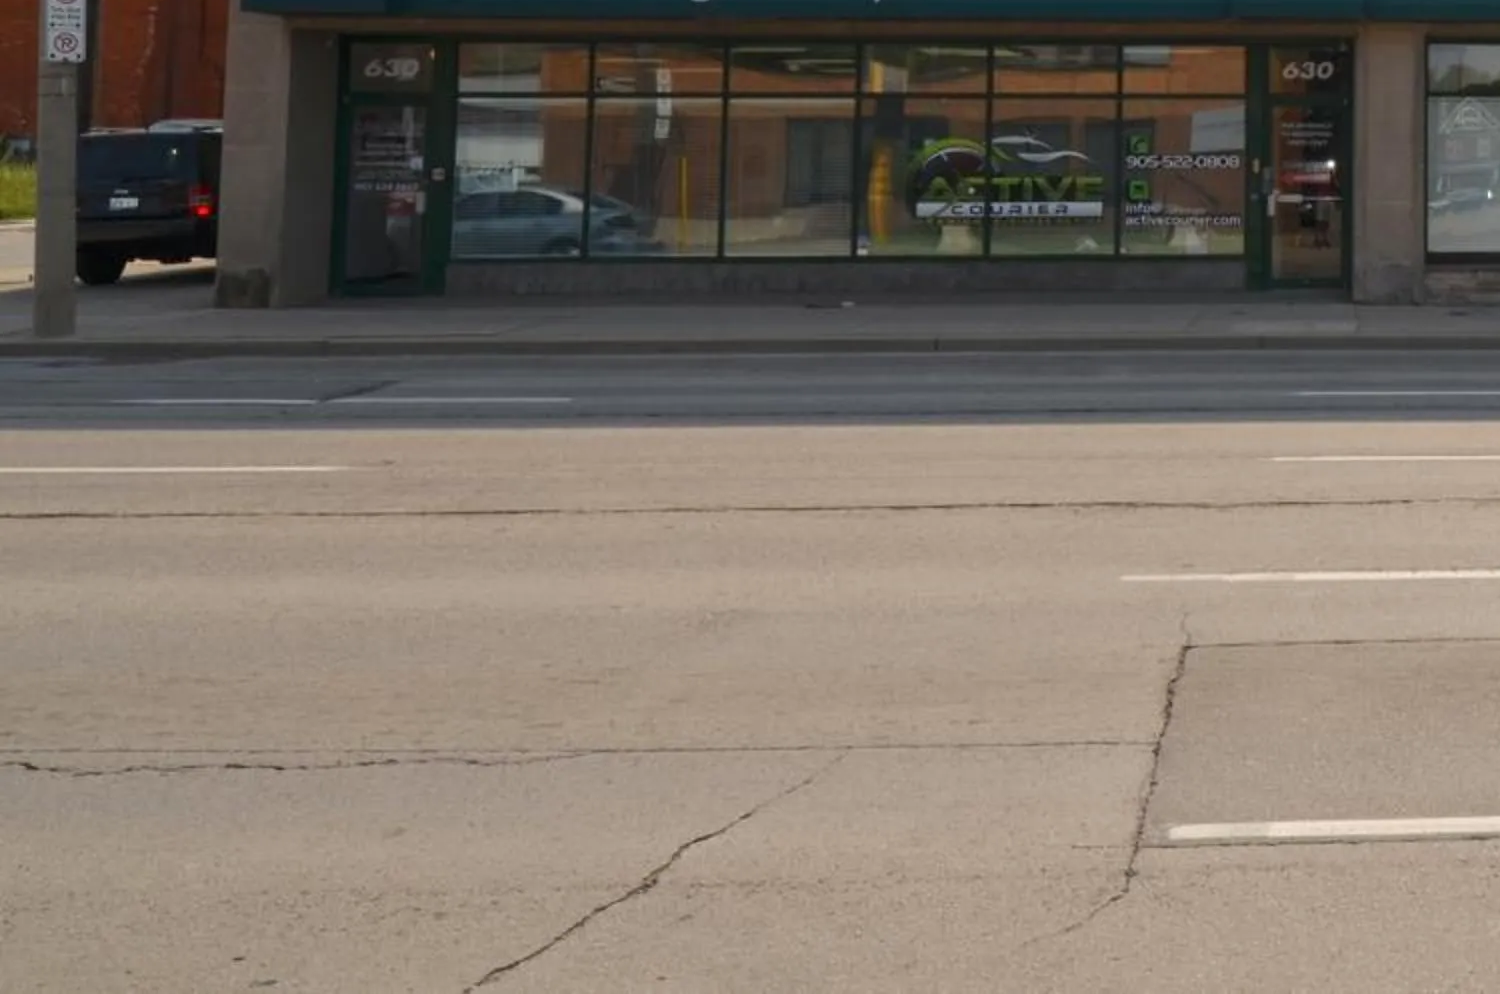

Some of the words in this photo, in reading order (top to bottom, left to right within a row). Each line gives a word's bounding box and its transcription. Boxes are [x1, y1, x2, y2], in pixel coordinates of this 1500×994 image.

[364, 58, 420, 78] 630
[1282, 61, 1335, 80] 630
[922, 176, 1104, 201] ACTIVE
[951, 204, 1068, 216] COURIER
